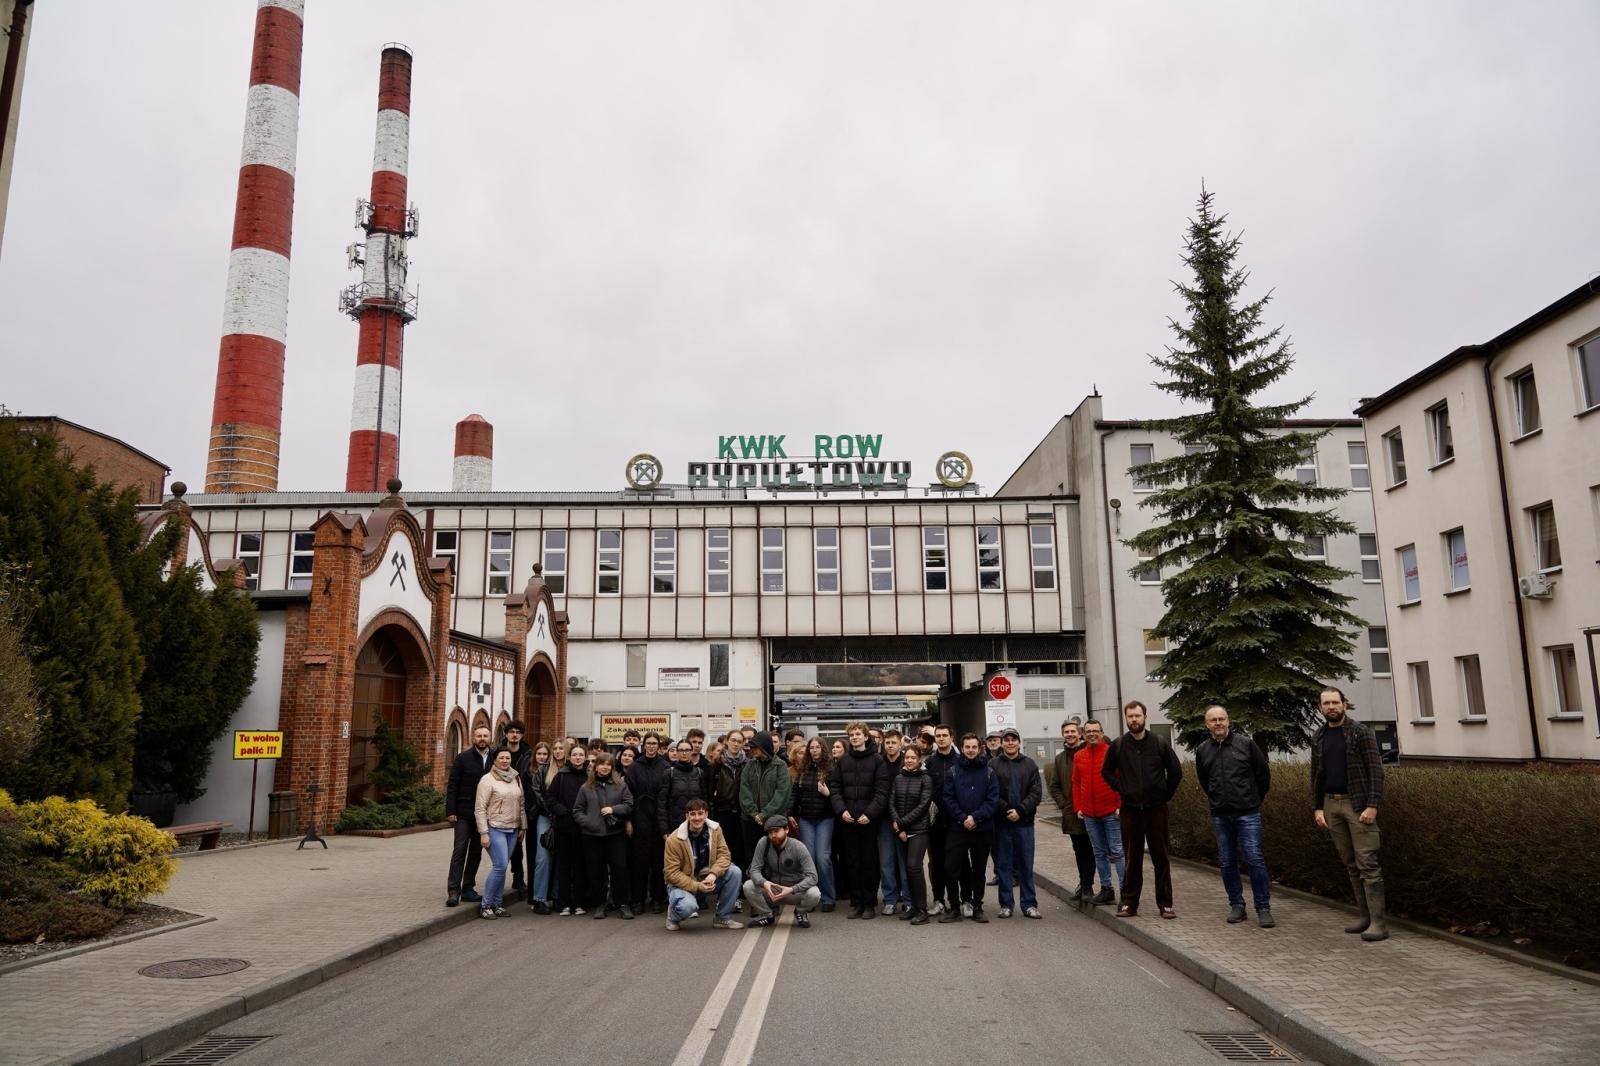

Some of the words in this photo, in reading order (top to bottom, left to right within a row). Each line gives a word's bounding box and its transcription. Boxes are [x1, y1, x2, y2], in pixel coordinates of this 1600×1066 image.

[718, 434, 787, 460] KWK
[815, 434, 883, 459] ROW
[687, 462, 911, 488] RYDUŁTOWY
[239, 734, 250, 742] Tu
[253, 734, 280, 742] wolno
[240, 746, 264, 756] palić
[267, 746, 277, 754] !!!
